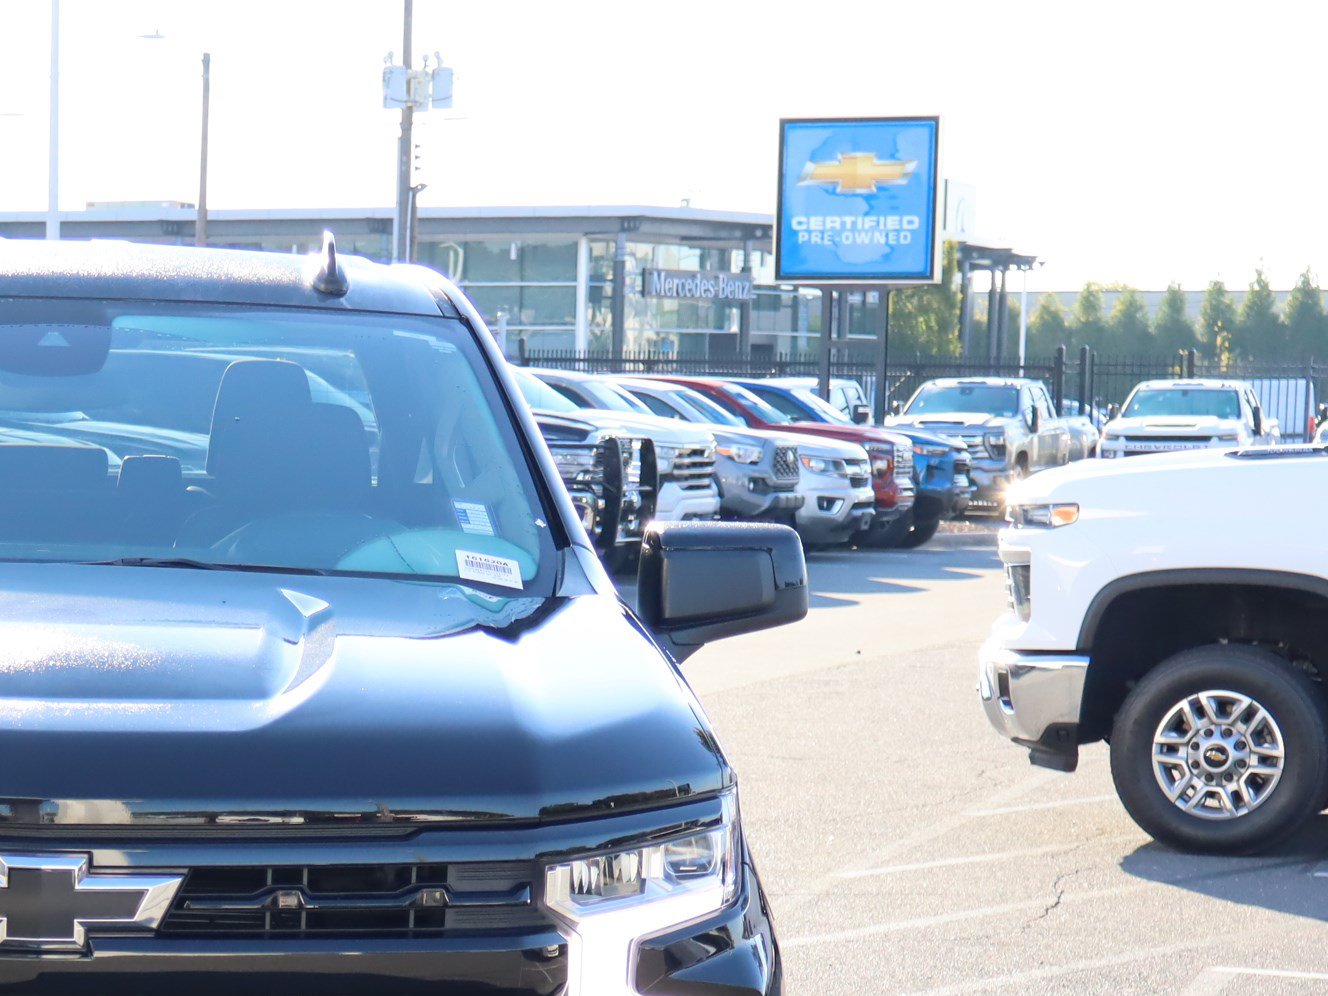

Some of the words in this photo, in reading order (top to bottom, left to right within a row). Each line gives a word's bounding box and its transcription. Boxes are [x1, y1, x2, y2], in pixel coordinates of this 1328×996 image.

[791, 215, 920, 231] CERTIFIED
[798, 231, 912, 245] PRE-OWNED
[652, 271, 750, 299] Mercedes-Benz
